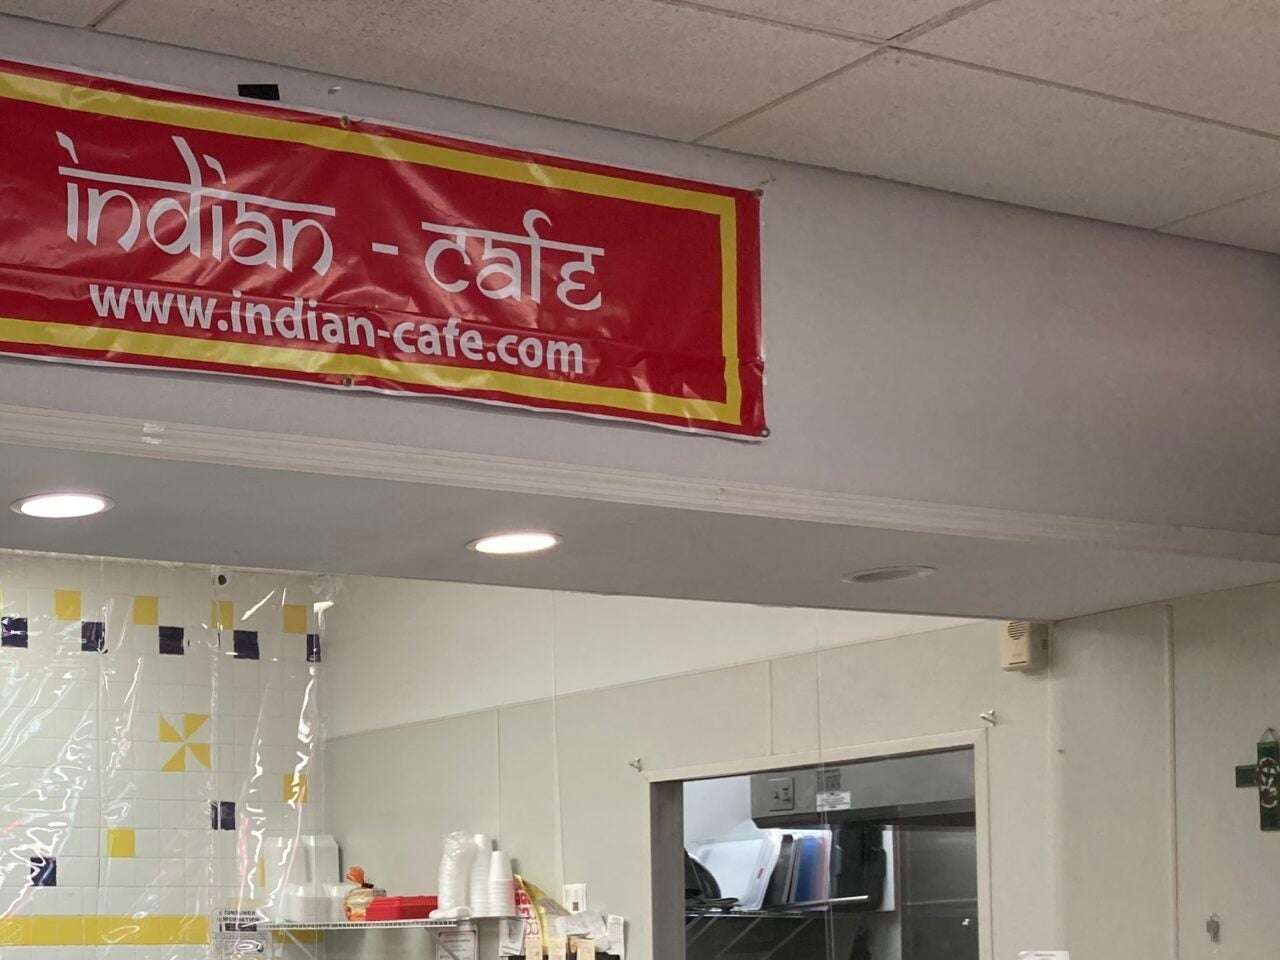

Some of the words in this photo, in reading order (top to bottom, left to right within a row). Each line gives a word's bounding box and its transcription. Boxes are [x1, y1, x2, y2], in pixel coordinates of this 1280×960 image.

[57, 131, 335, 277] indian
[422, 209, 605, 311] cafe
[89, 284, 584, 377] www.indian-cafe.com
